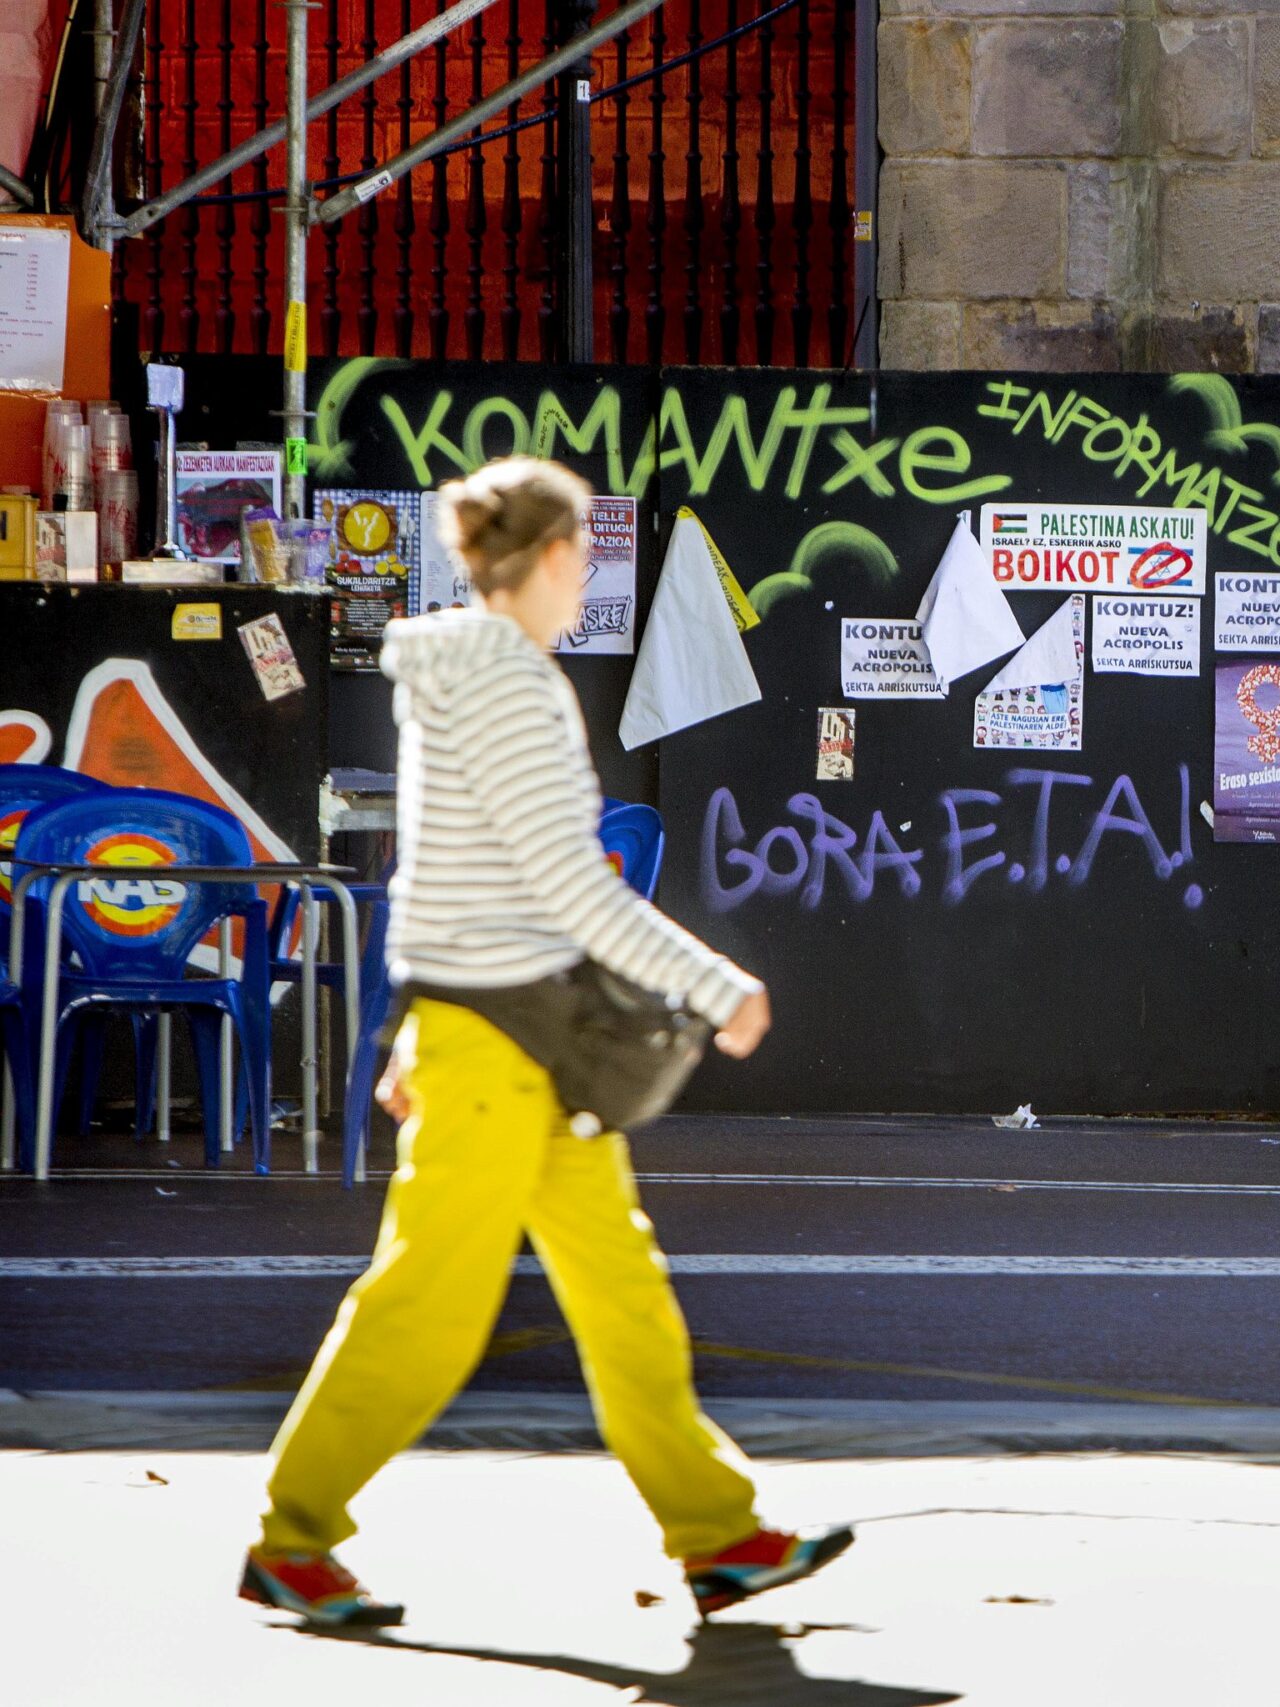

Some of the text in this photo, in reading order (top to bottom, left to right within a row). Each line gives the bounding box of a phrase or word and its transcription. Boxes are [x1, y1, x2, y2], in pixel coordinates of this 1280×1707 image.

[592, 511, 626, 521] TELLE
[593, 523, 633, 533] DITUGU
[1040, 513, 1195, 540] PALESTINA ASKATU!
[992, 538, 1122, 548] ISRAEL? EZ, ESKERRIK ASKO
[992, 549, 1120, 584] BOIKOT
[1097, 601, 1194, 618] KONTUZ!
[1119, 626, 1169, 637] NUEVA
[1103, 639, 1184, 650] ACROPOLIS
[1218, 634, 1249, 645] SEKTA
[868, 649, 918, 660] NUEVA
[852, 662, 933, 673] ACROPOLIS
[1096, 658, 1193, 670] SEKTA ARRISKUTSUA
[846, 681, 942, 693] SEKTA ARRISKUTSUA
[991, 713, 1009, 722] ASTE
[1011, 714, 1049, 723] NAGUSIAN
[990, 720, 1043, 731] PALESTINAREN
[1219, 773, 1247, 791] Eraso
[77, 876, 188, 906] KAS
